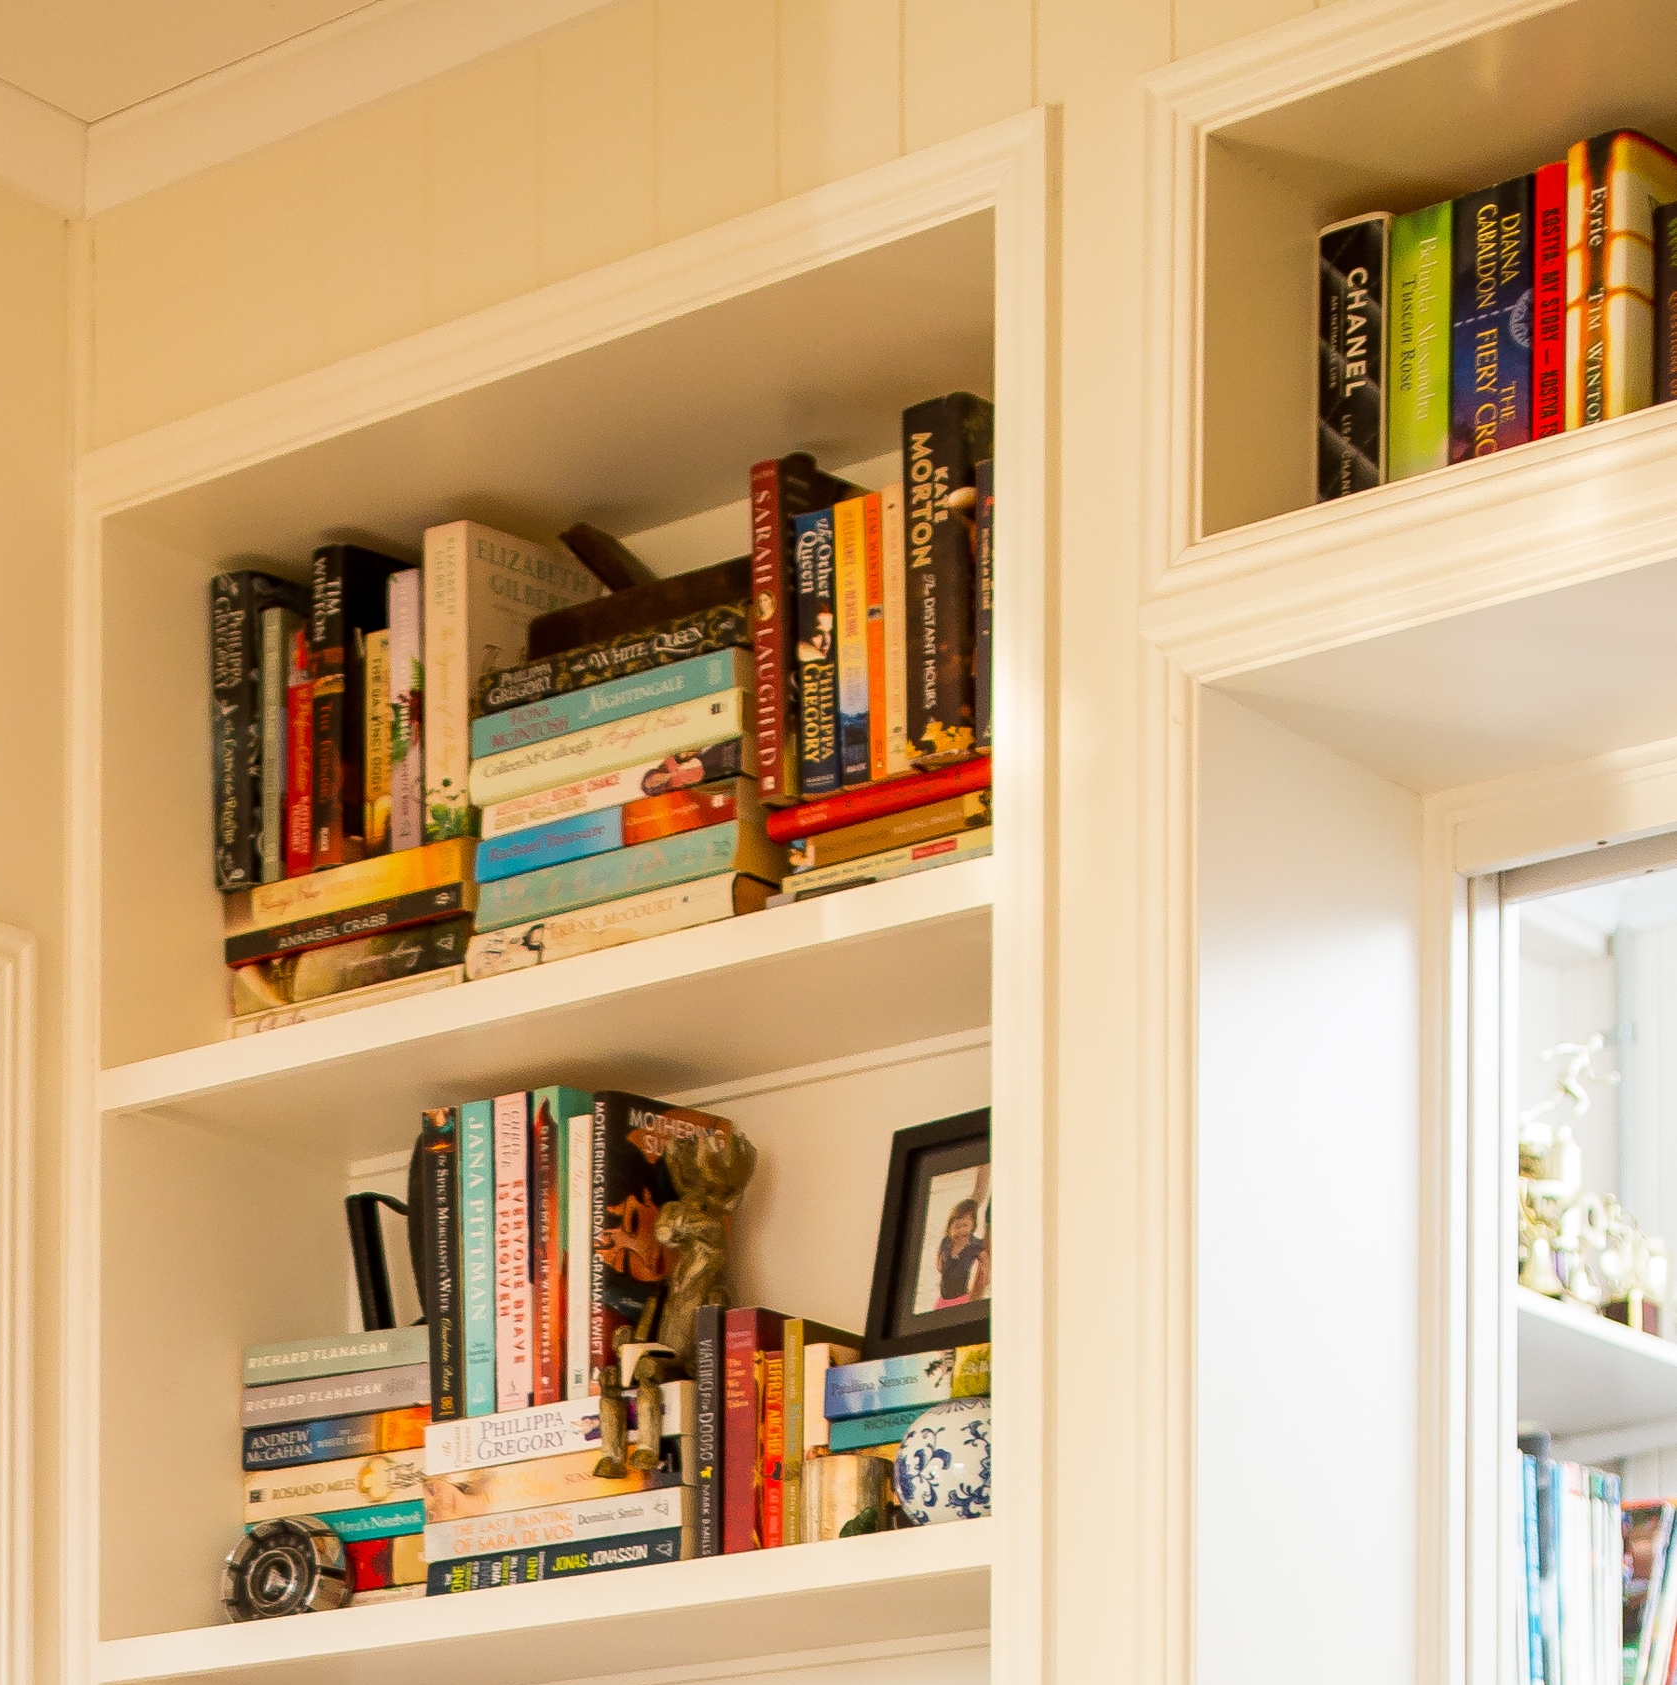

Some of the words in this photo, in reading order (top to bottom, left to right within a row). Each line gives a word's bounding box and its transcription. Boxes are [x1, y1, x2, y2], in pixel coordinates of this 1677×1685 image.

[1585, 186, 1608, 247] Eyrie
[1476, 204, 1500, 311] GABALDON
[1501, 212, 1521, 286] DIANA
[1417, 237, 1438, 314] Belinda
[1542, 270, 1560, 292] MY
[1345, 266, 1367, 397] CHANEL
[1400, 276, 1418, 346] Tuscan
[1541, 298, 1560, 342] STORY
[1587, 288, 1605, 331] TIM
[1400, 349, 1416, 392] Rose
[1416, 322, 1439, 423] Alexandra
[1476, 327, 1500, 394] FIERY
[1501, 381, 1520, 423] THE
[1539, 369, 1559, 419] KOSTYA
[1476, 402, 1500, 456] CRO
[909, 431, 934, 568] MORTON
[933, 466, 949, 523] KATE
[754, 489, 774, 585] SARAH
[796, 530, 818, 595] Queen
[312, 557, 327, 643] WINTON
[326, 577, 342, 616] TIM
[588, 641, 649, 669] WHITE
[652, 627, 704, 653] QUEEN
[924, 597, 937, 656] DISTANT
[755, 627, 776, 767] LAUGHED
[924, 658, 937, 710] HOURS
[802, 662, 821, 764] GREGORY
[819, 662, 836, 759] PHILIPPA
[278, 926, 338, 949] ANNABEL
[342, 912, 388, 934] CRABB
[468, 1116, 486, 1189] JANA
[591, 1101, 605, 1183] MOTHERING
[499, 1183, 510, 1200] IS
[591, 1186, 604, 1240] SUNDAY
[469, 1199, 487, 1321] PITTMAN
[513, 1179, 525, 1289] EVERYONE
[499, 1210, 510, 1317] FORGIVEN
[540, 1258, 551, 1276] IN
[591, 1252, 604, 1311] GRAHAM
[513, 1299, 525, 1364] BRAVE
[540, 1280, 551, 1362] WILDERNESS
[591, 1315, 603, 1355] SWIFT
[248, 1351, 309, 1370] RICHARD
[313, 1340, 389, 1362] FLANAGAN
[698, 1339, 714, 1391] WAITING
[245, 1394, 306, 1413] RICHARD
[309, 1382, 383, 1403] FLANAGAN
[766, 1358, 782, 1405] JEFFREY
[250, 1429, 310, 1451] ANDREW
[477, 1429, 568, 1462] GREGORY
[480, 1410, 566, 1441] PHILIPPA
[699, 1412, 714, 1460] DOGGO
[768, 1409, 782, 1456] ARCHER
[272, 1482, 325, 1501] ROSALIND
[327, 1477, 358, 1494] MILES
[452, 1538, 473, 1556] OF
[478, 1531, 516, 1551] SARA
[522, 1529, 541, 1545] DE
[544, 1524, 574, 1542] VOS
[479, 1517, 509, 1533] LAST
[512, 1508, 572, 1528] PAINTING
[577, 1512, 616, 1527] Dominic
[618, 1506, 645, 1520] Smith
[452, 1566, 464, 1592] ONE
[526, 1556, 538, 1580] AND
[552, 1552, 589, 1573] JONAS
[589, 1544, 649, 1567] JONASSON
